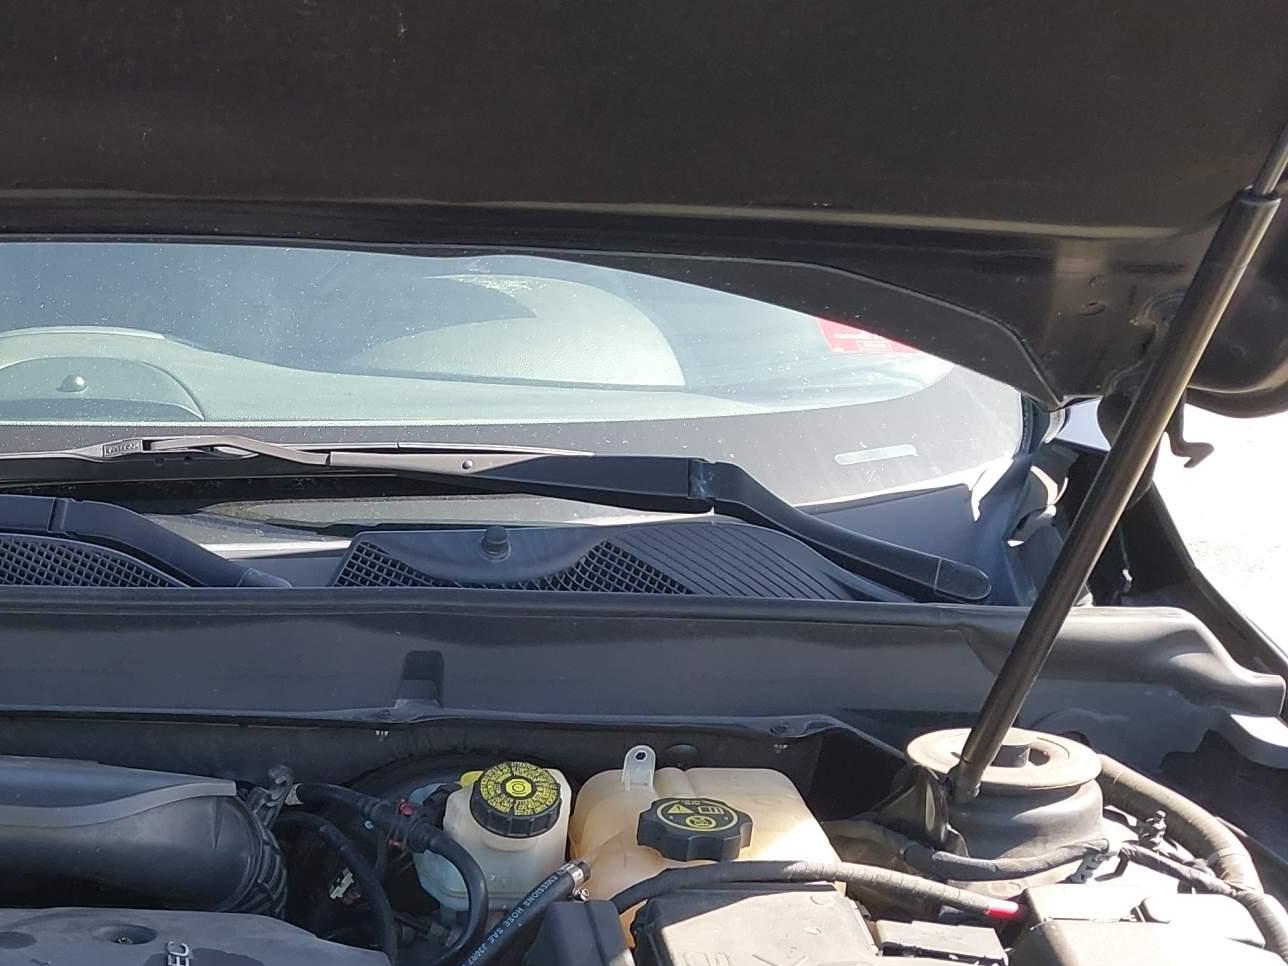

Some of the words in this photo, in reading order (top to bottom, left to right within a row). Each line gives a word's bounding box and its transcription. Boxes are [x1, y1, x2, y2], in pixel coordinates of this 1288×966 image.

[503, 906, 524, 929] HOSE
[486, 927, 505, 945] SAE
[467, 943, 489, 966] J30R7
